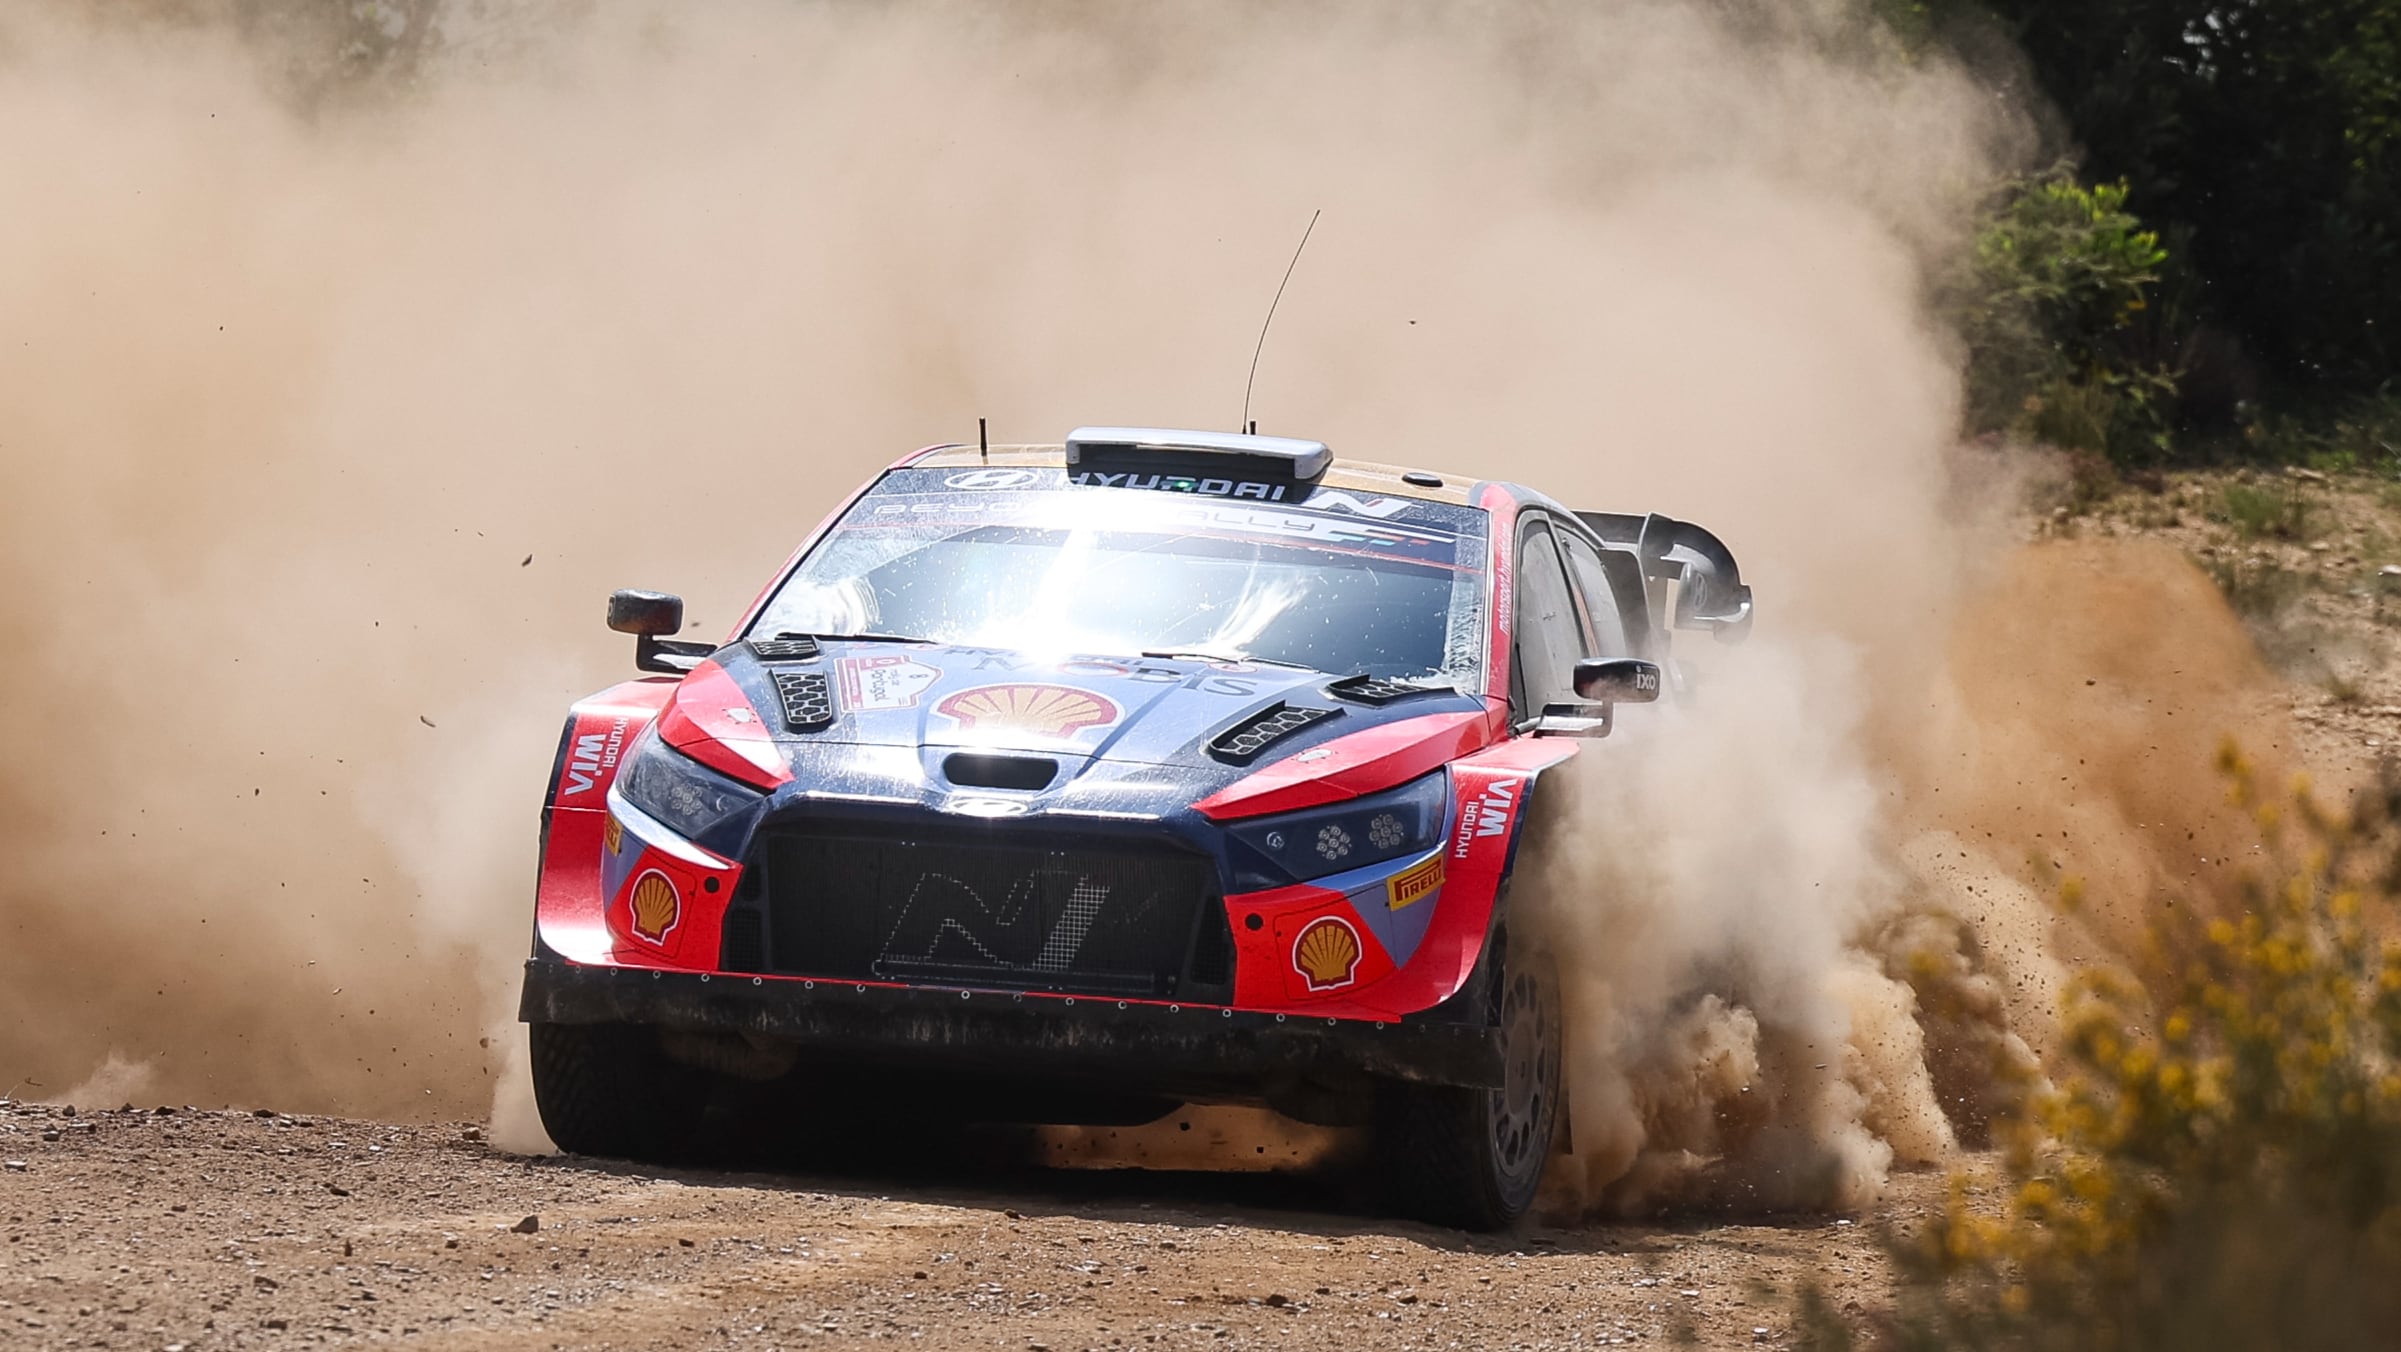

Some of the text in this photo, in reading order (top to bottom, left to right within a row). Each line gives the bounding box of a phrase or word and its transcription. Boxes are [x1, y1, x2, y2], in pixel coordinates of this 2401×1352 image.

[1176, 510, 1316, 532] ALLY
[603, 717, 629, 768] HYUNDAI
[1455, 801, 1478, 858] HYUNDAI
[1393, 858, 1441, 901] PIRELLI
